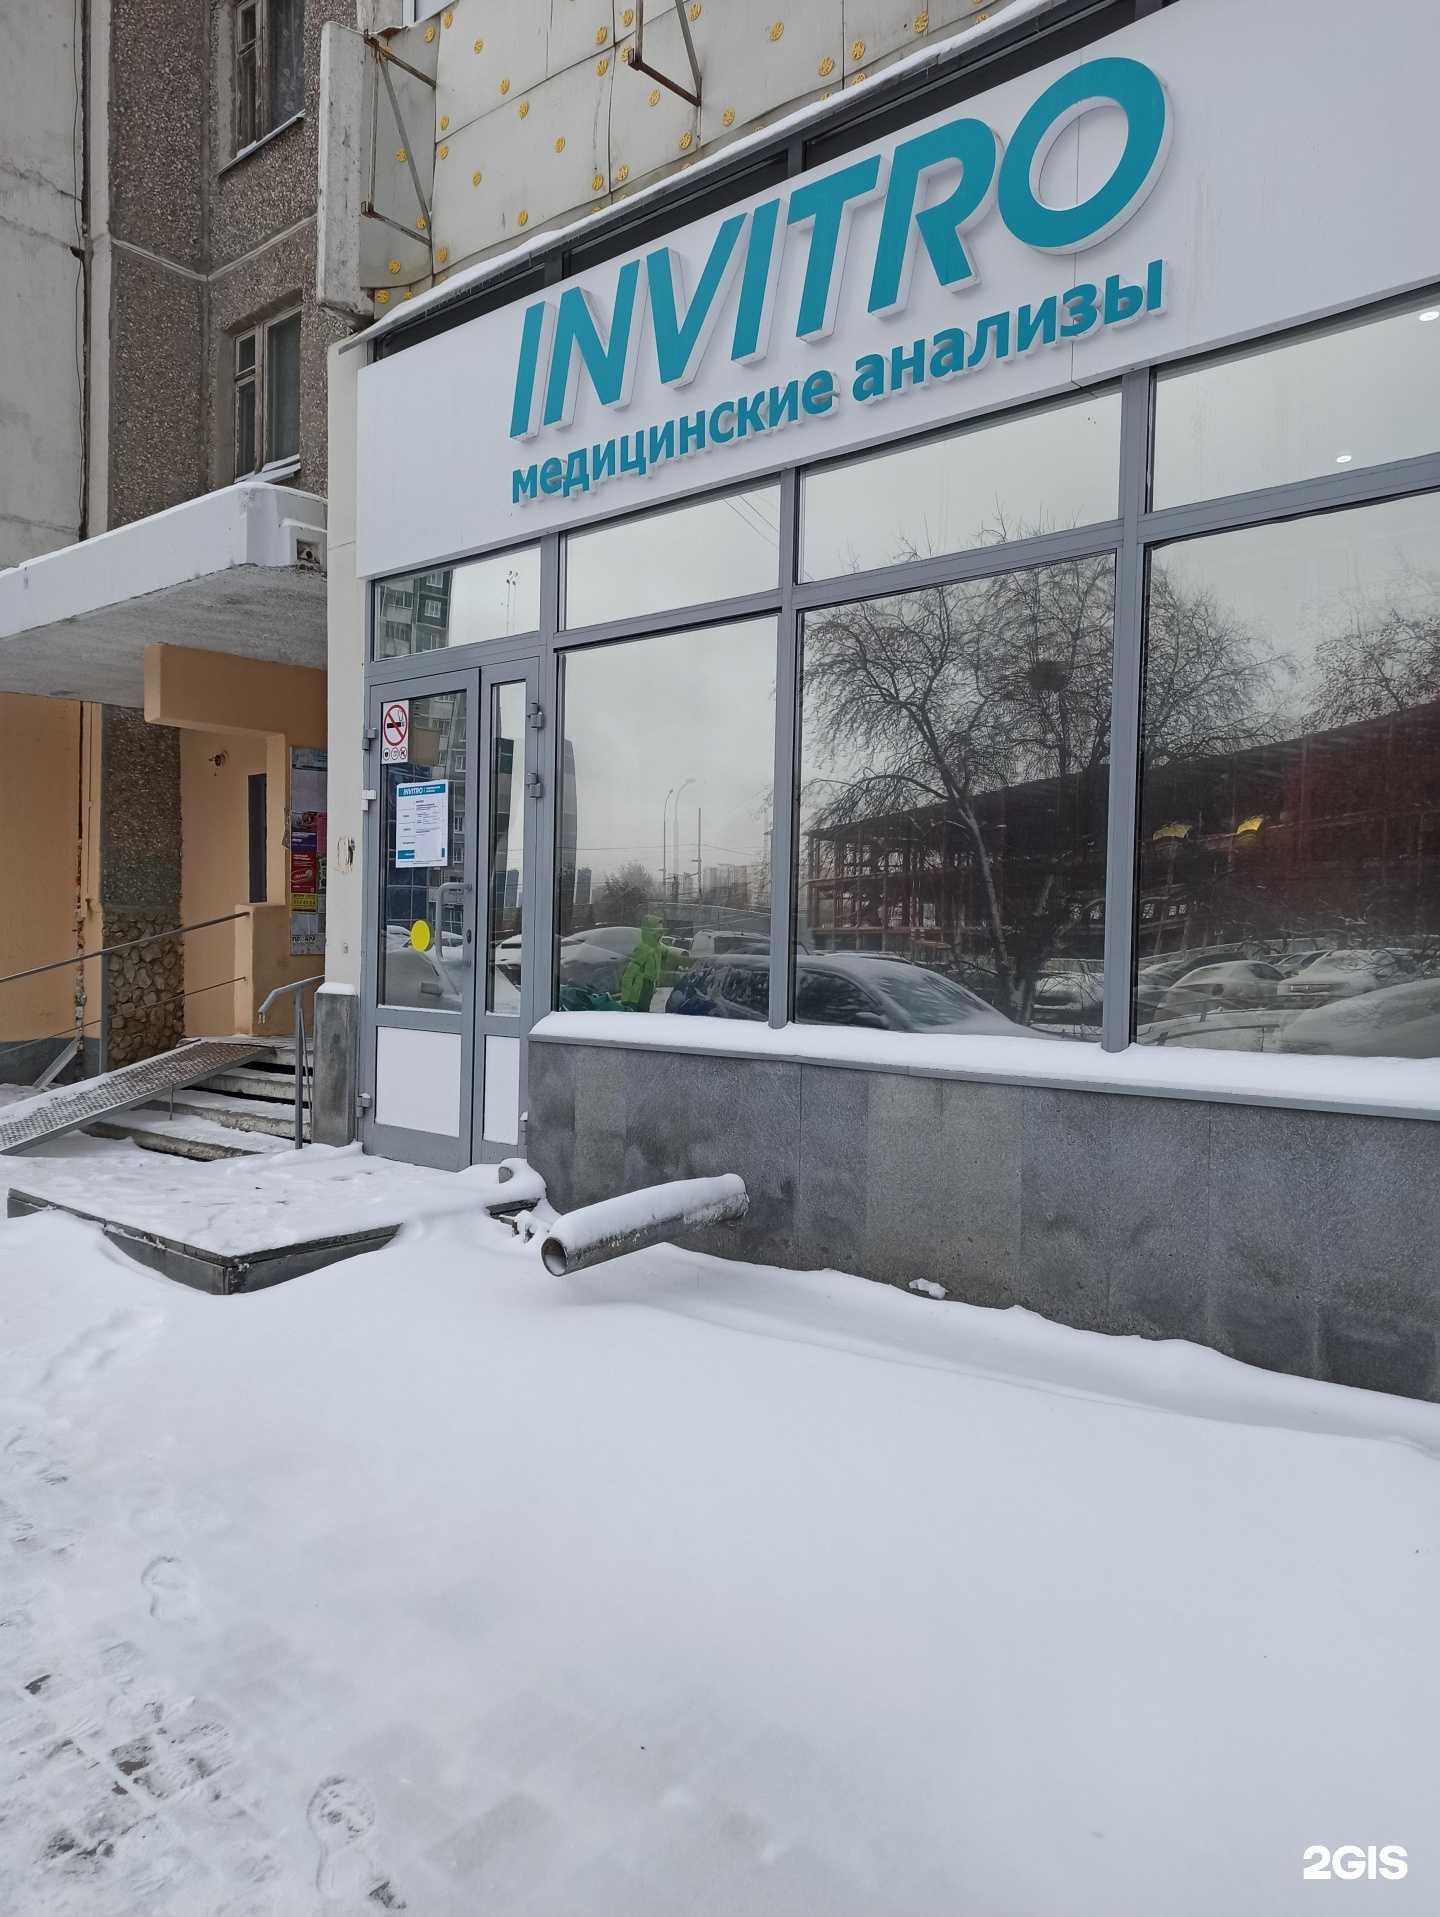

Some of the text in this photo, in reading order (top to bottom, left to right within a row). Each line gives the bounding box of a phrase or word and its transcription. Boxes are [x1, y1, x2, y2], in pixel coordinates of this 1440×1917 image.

[509, 56, 1168, 440] INVITRO
[511, 259, 1164, 504] медицинские анализы
